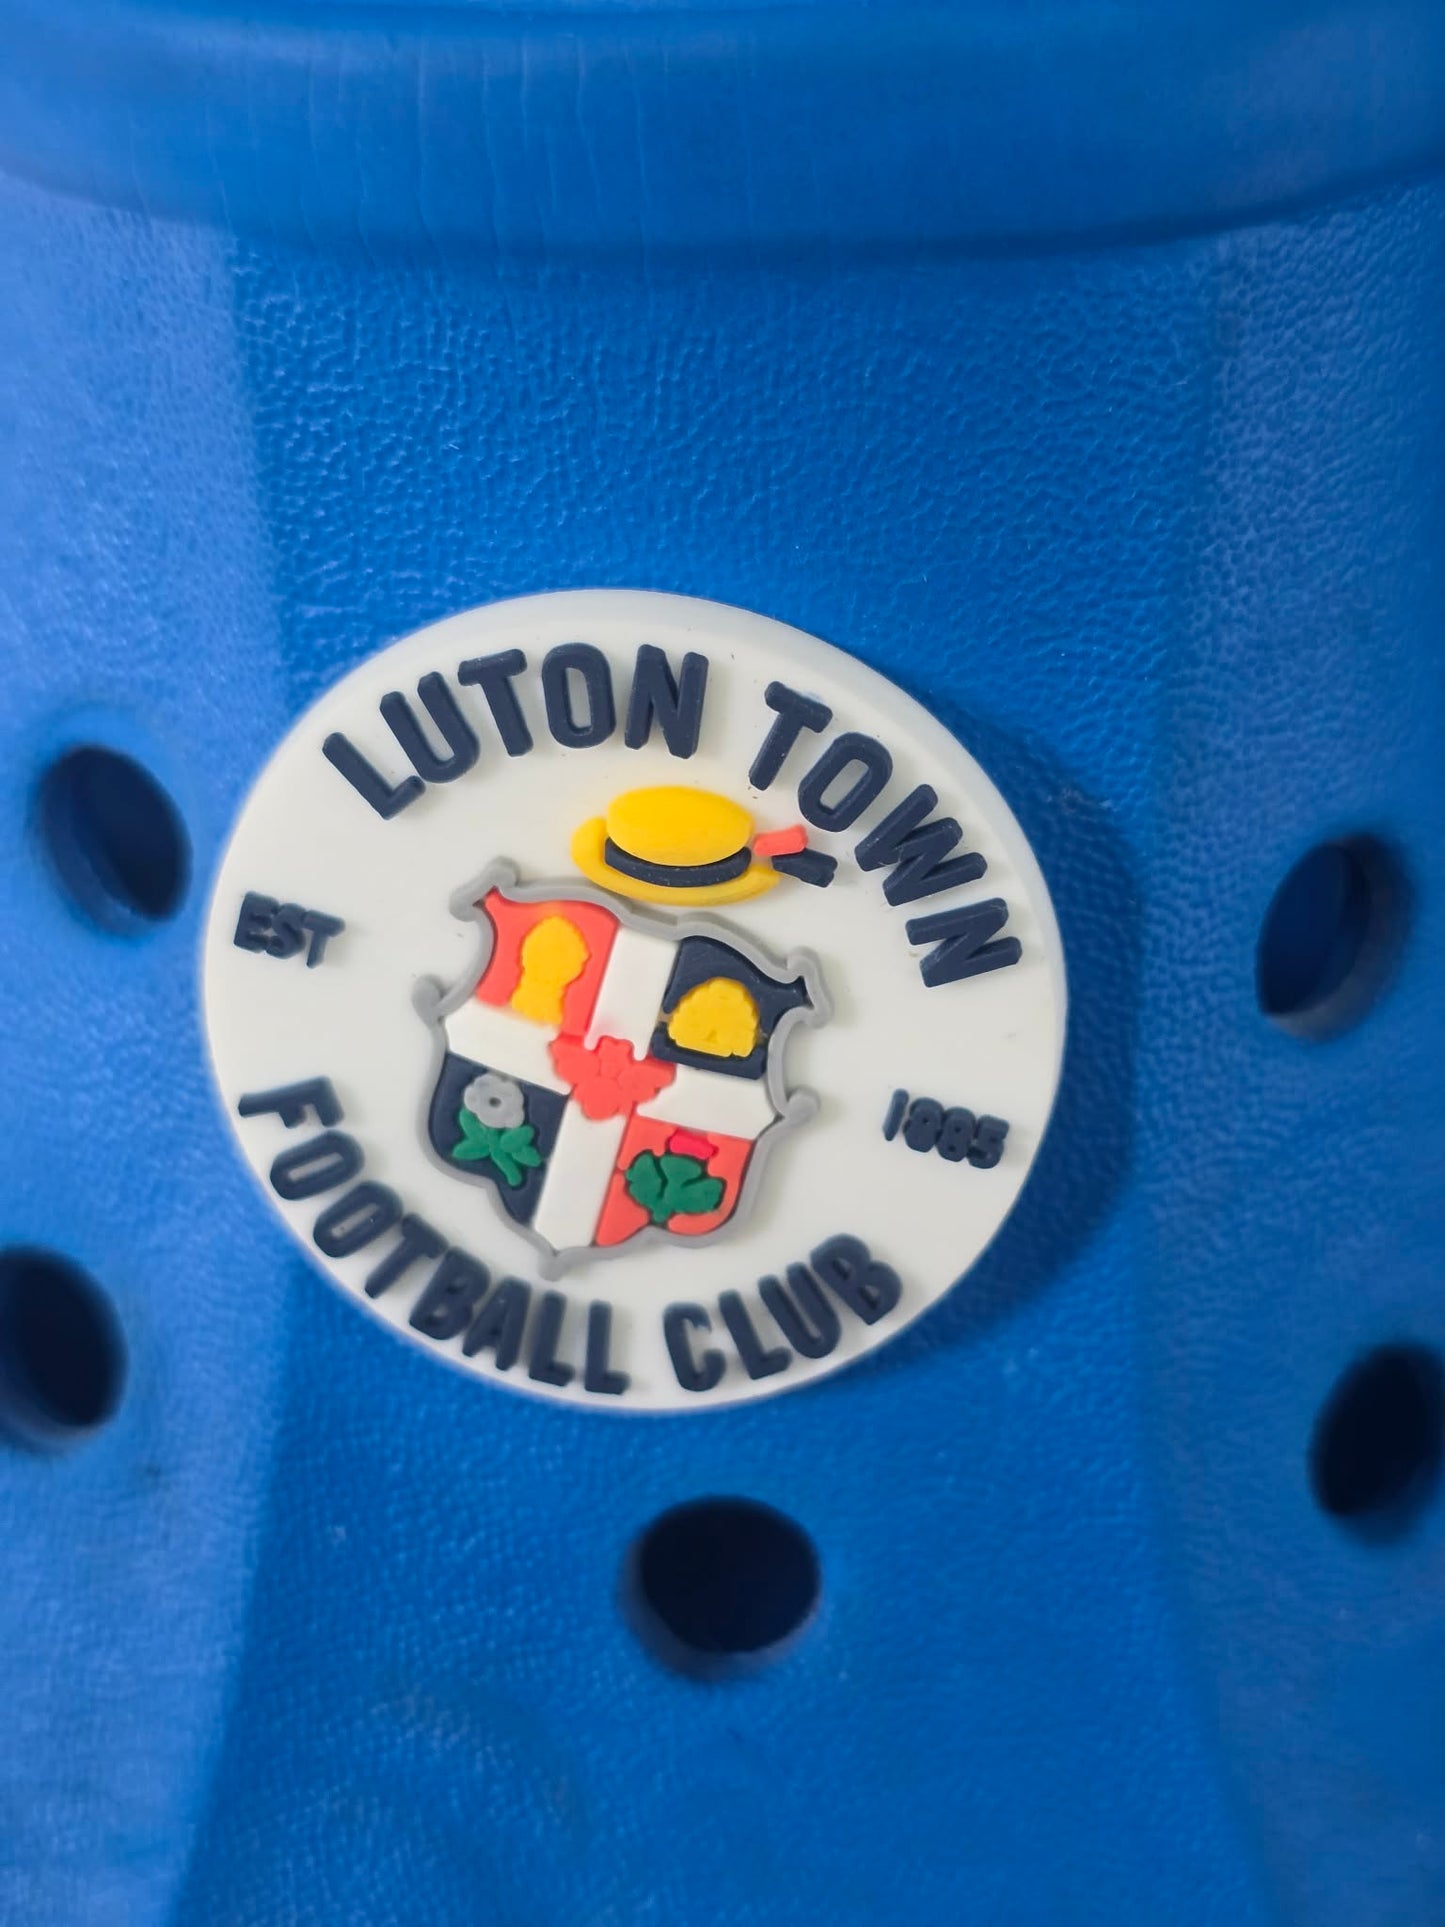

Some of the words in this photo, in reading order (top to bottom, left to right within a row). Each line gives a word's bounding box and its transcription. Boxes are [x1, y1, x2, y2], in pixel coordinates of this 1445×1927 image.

[322, 643, 709, 820] LUTON
[749, 681, 1023, 988] TOWN
[233, 891, 345, 968] EST
[882, 1088, 1010, 1169] 1885
[238, 1075, 630, 1395] FOOTBALL
[663, 1233, 903, 1391] CLUB
